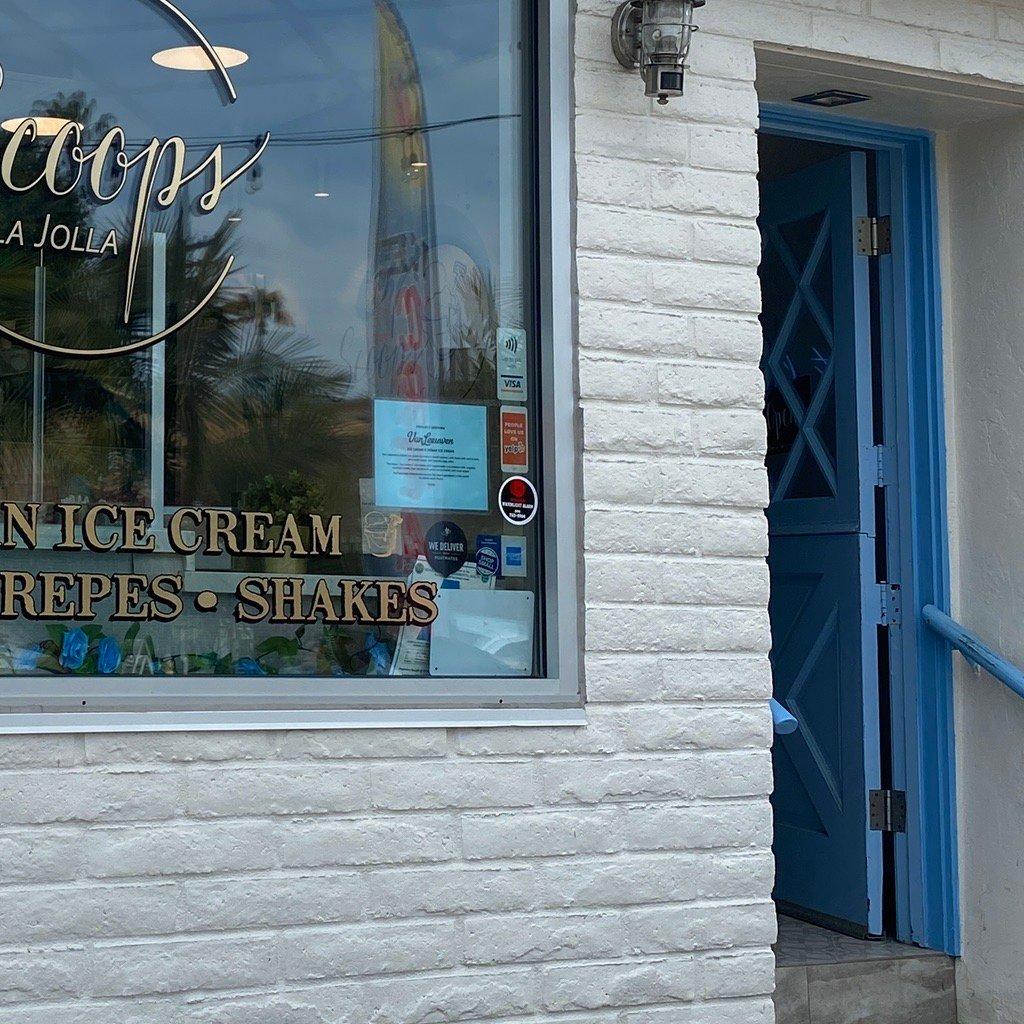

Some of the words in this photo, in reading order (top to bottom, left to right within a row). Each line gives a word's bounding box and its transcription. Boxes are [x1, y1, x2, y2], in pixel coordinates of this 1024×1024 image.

[34, 212, 119, 256] JOLLA
[503, 380, 522, 388] VISA
[56, 503, 156, 553] ICE
[166, 506, 343, 557] CREAM
[428, 541, 439, 550] WE
[440, 542, 464, 552] DELIVER
[234, 579, 440, 627] SHAKES
